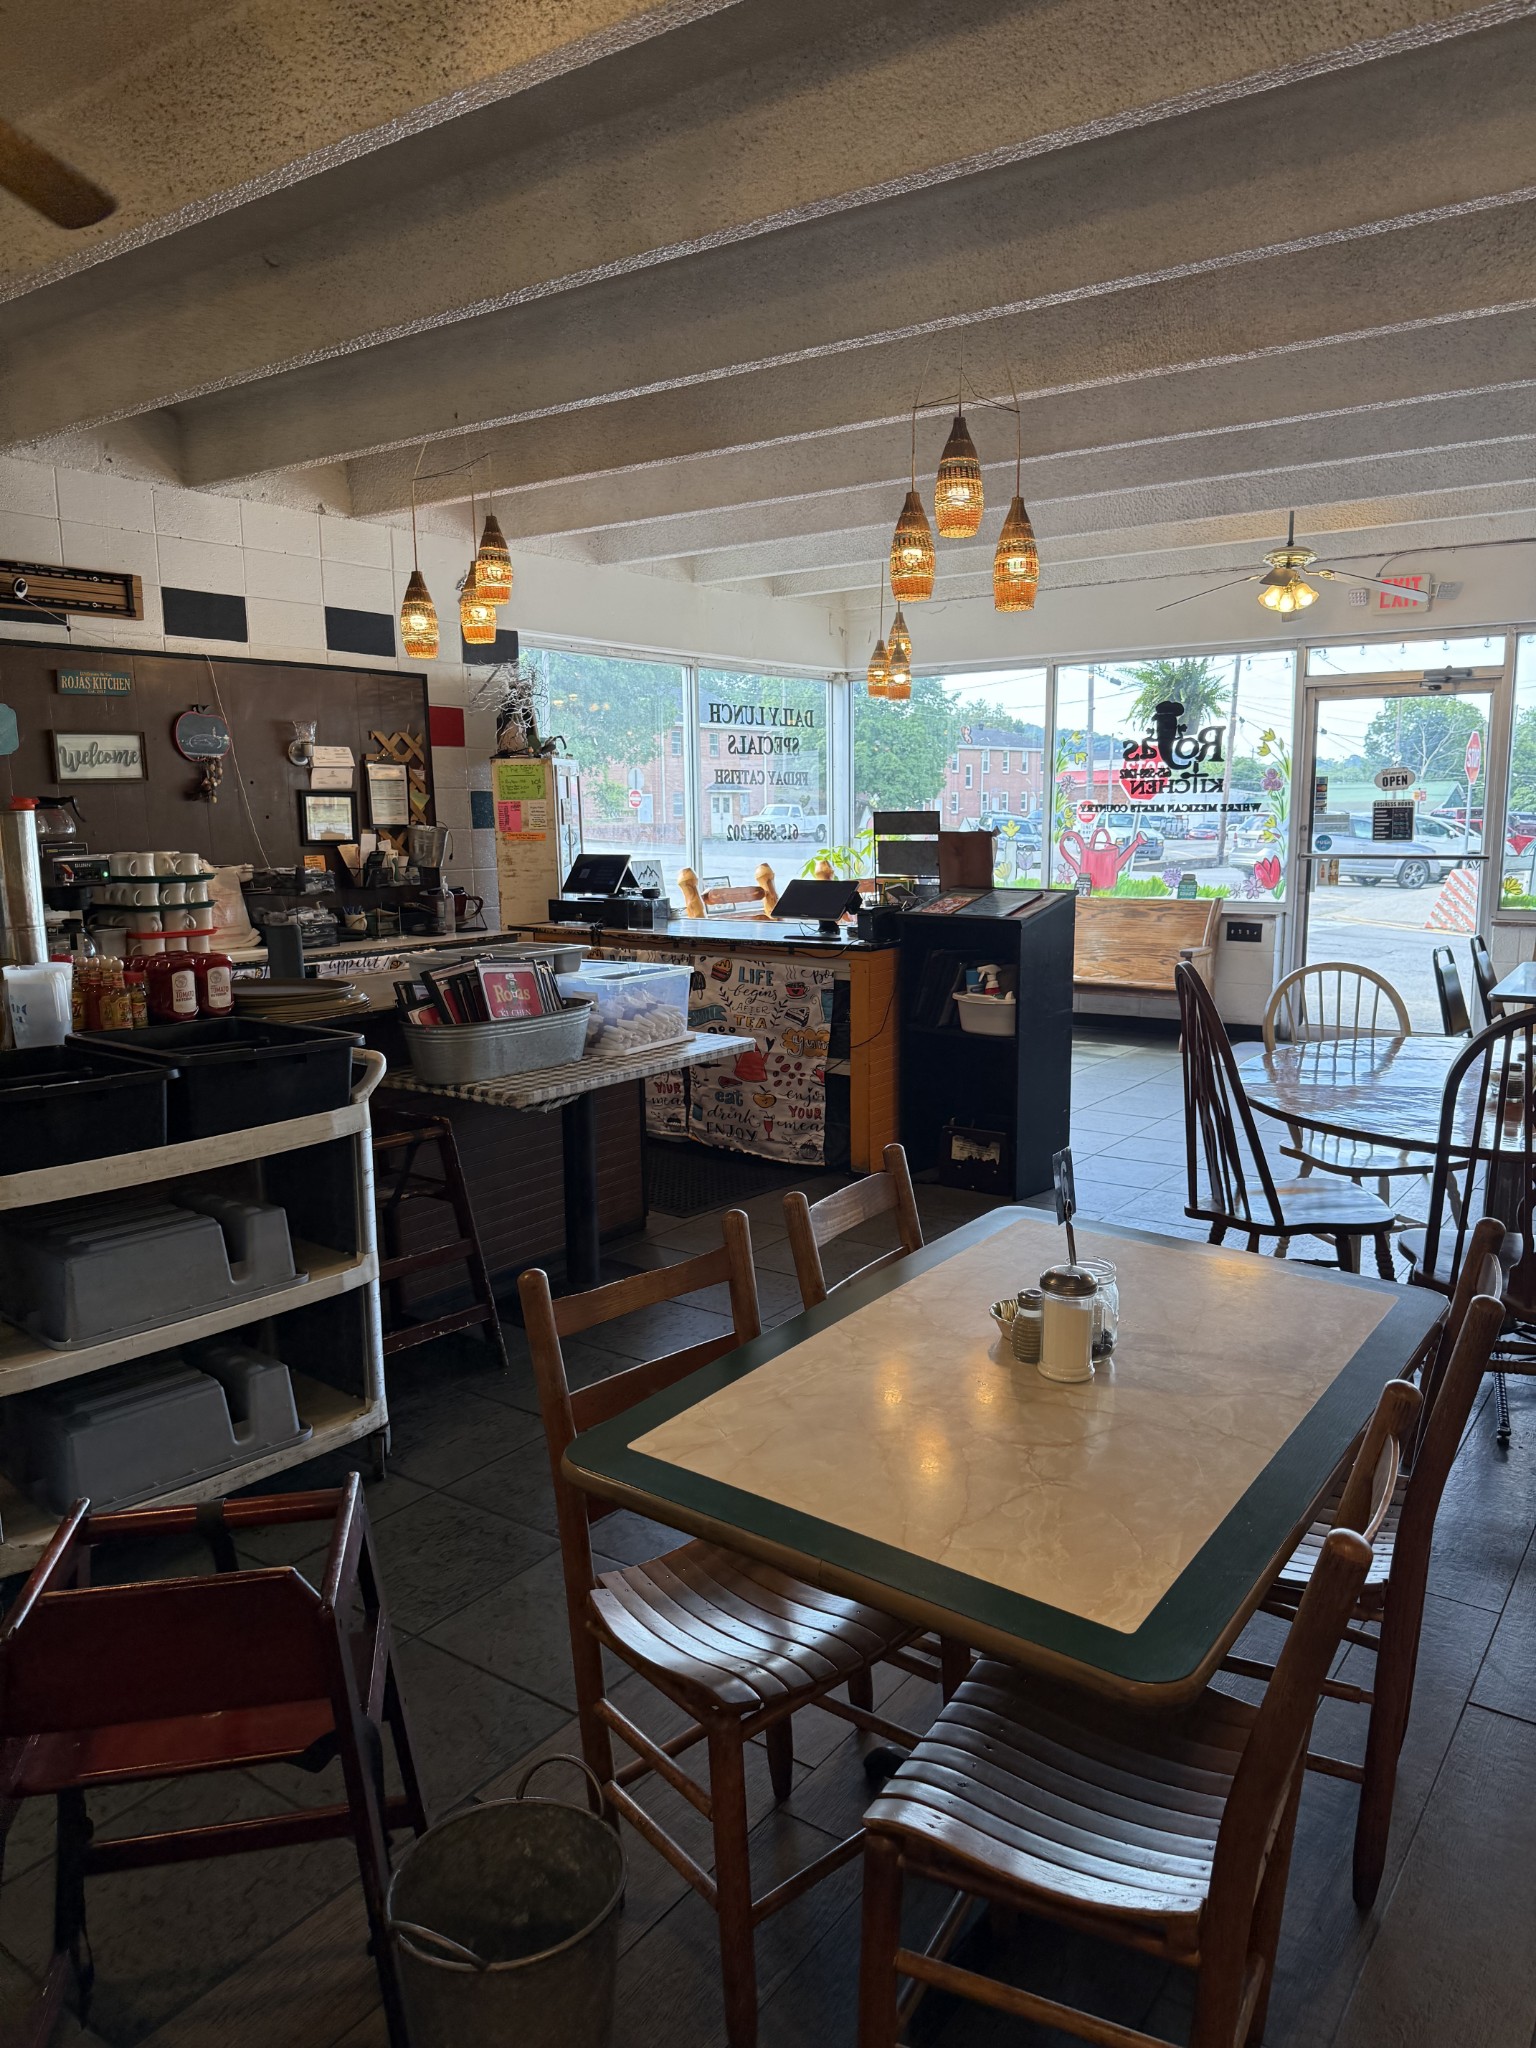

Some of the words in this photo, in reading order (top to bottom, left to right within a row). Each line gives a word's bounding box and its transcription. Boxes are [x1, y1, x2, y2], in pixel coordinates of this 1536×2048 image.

[1380, 577, 1422, 608] EXIT
[61, 676, 90, 689] ROJAS
[92, 677, 131, 690] KITCHEN
[60, 741, 141, 773] Welcome
[1467, 748, 1480, 768] STOP
[1382, 775, 1408, 787] OPEN
[739, 966, 774, 986] LIFE
[731, 984, 778, 1005] begins
[732, 1002, 771, 1014] AFTER
[734, 1014, 767, 1029] TEA
[652, 1097, 682, 1106] mea
[715, 1090, 743, 1107] eat
[707, 1104, 760, 1128] drink
[788, 1105, 822, 1120] YOUR
[707, 1121, 757, 1141] ENJOY
[777, 1121, 825, 1132] mea
